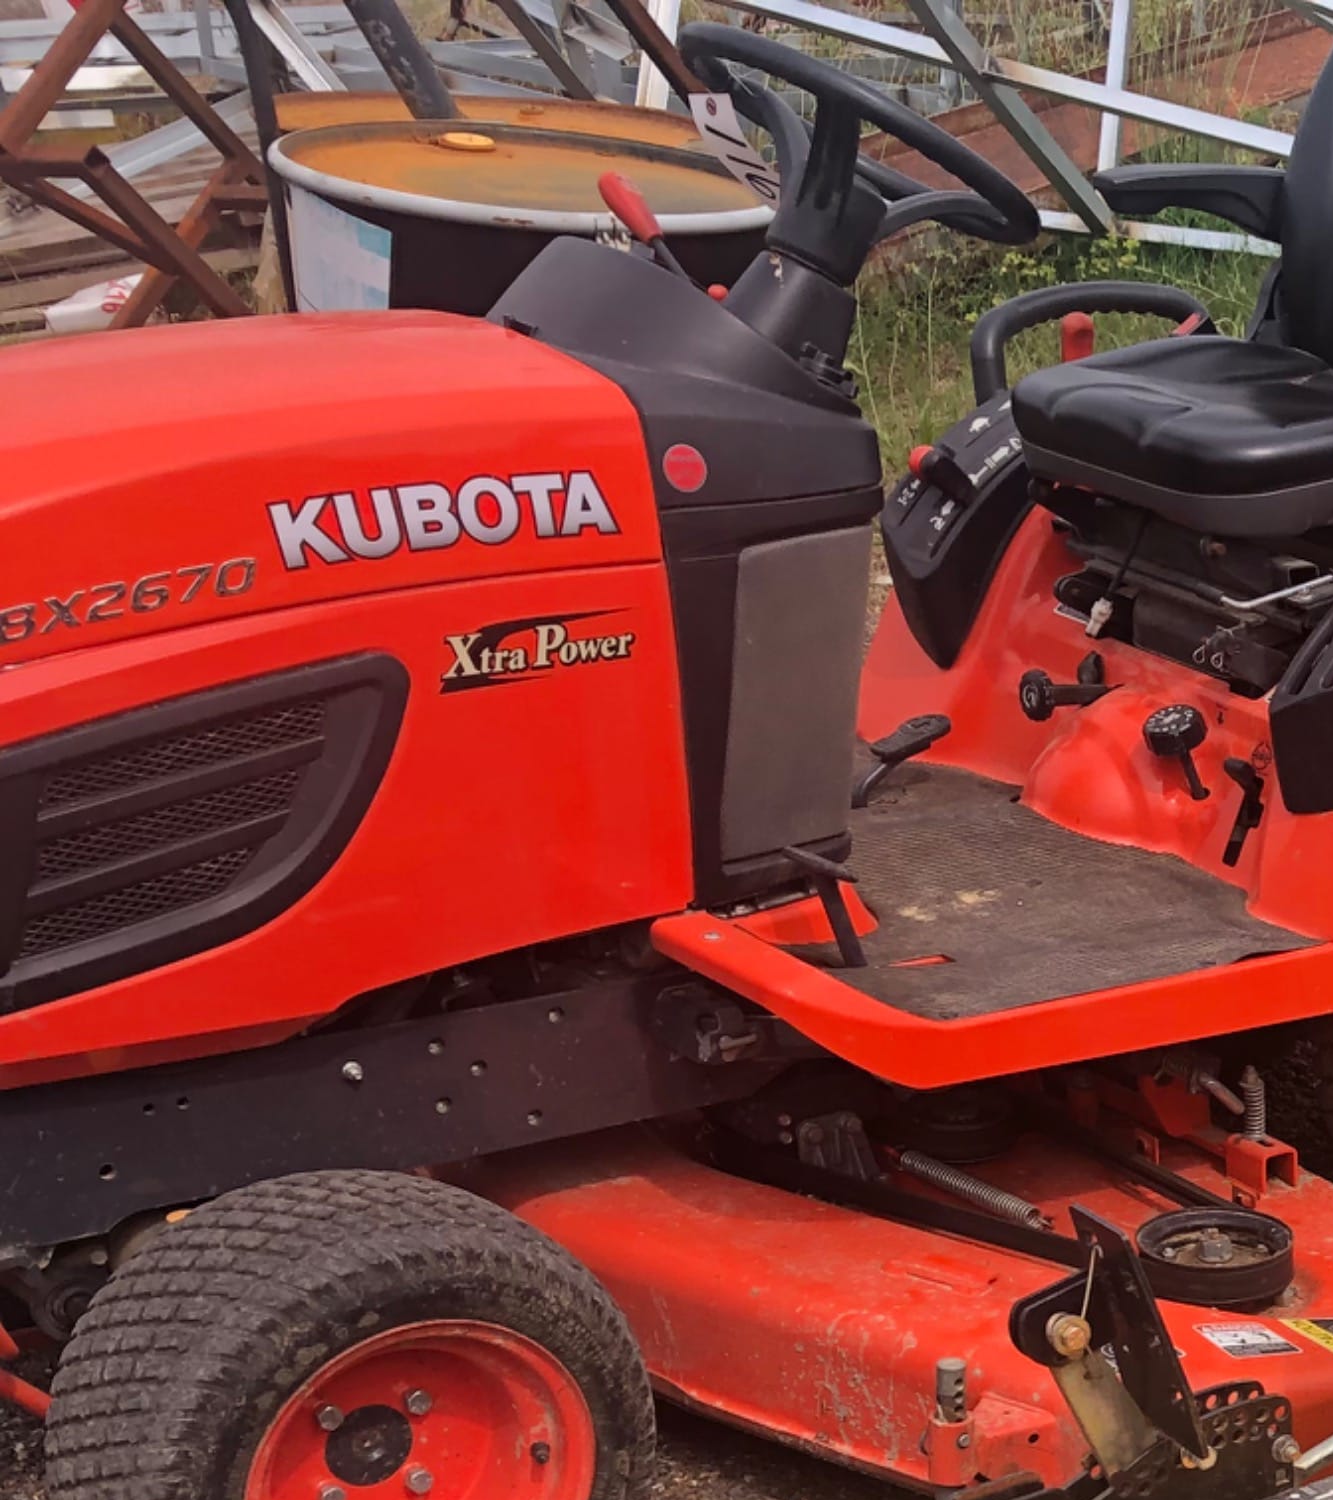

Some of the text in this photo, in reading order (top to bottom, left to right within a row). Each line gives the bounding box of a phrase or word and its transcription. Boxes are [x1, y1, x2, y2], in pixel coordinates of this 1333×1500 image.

[268, 471, 622, 570] KUBOTA
[0, 557, 256, 644] BX2670
[442, 624, 633, 680] Xtra Power
